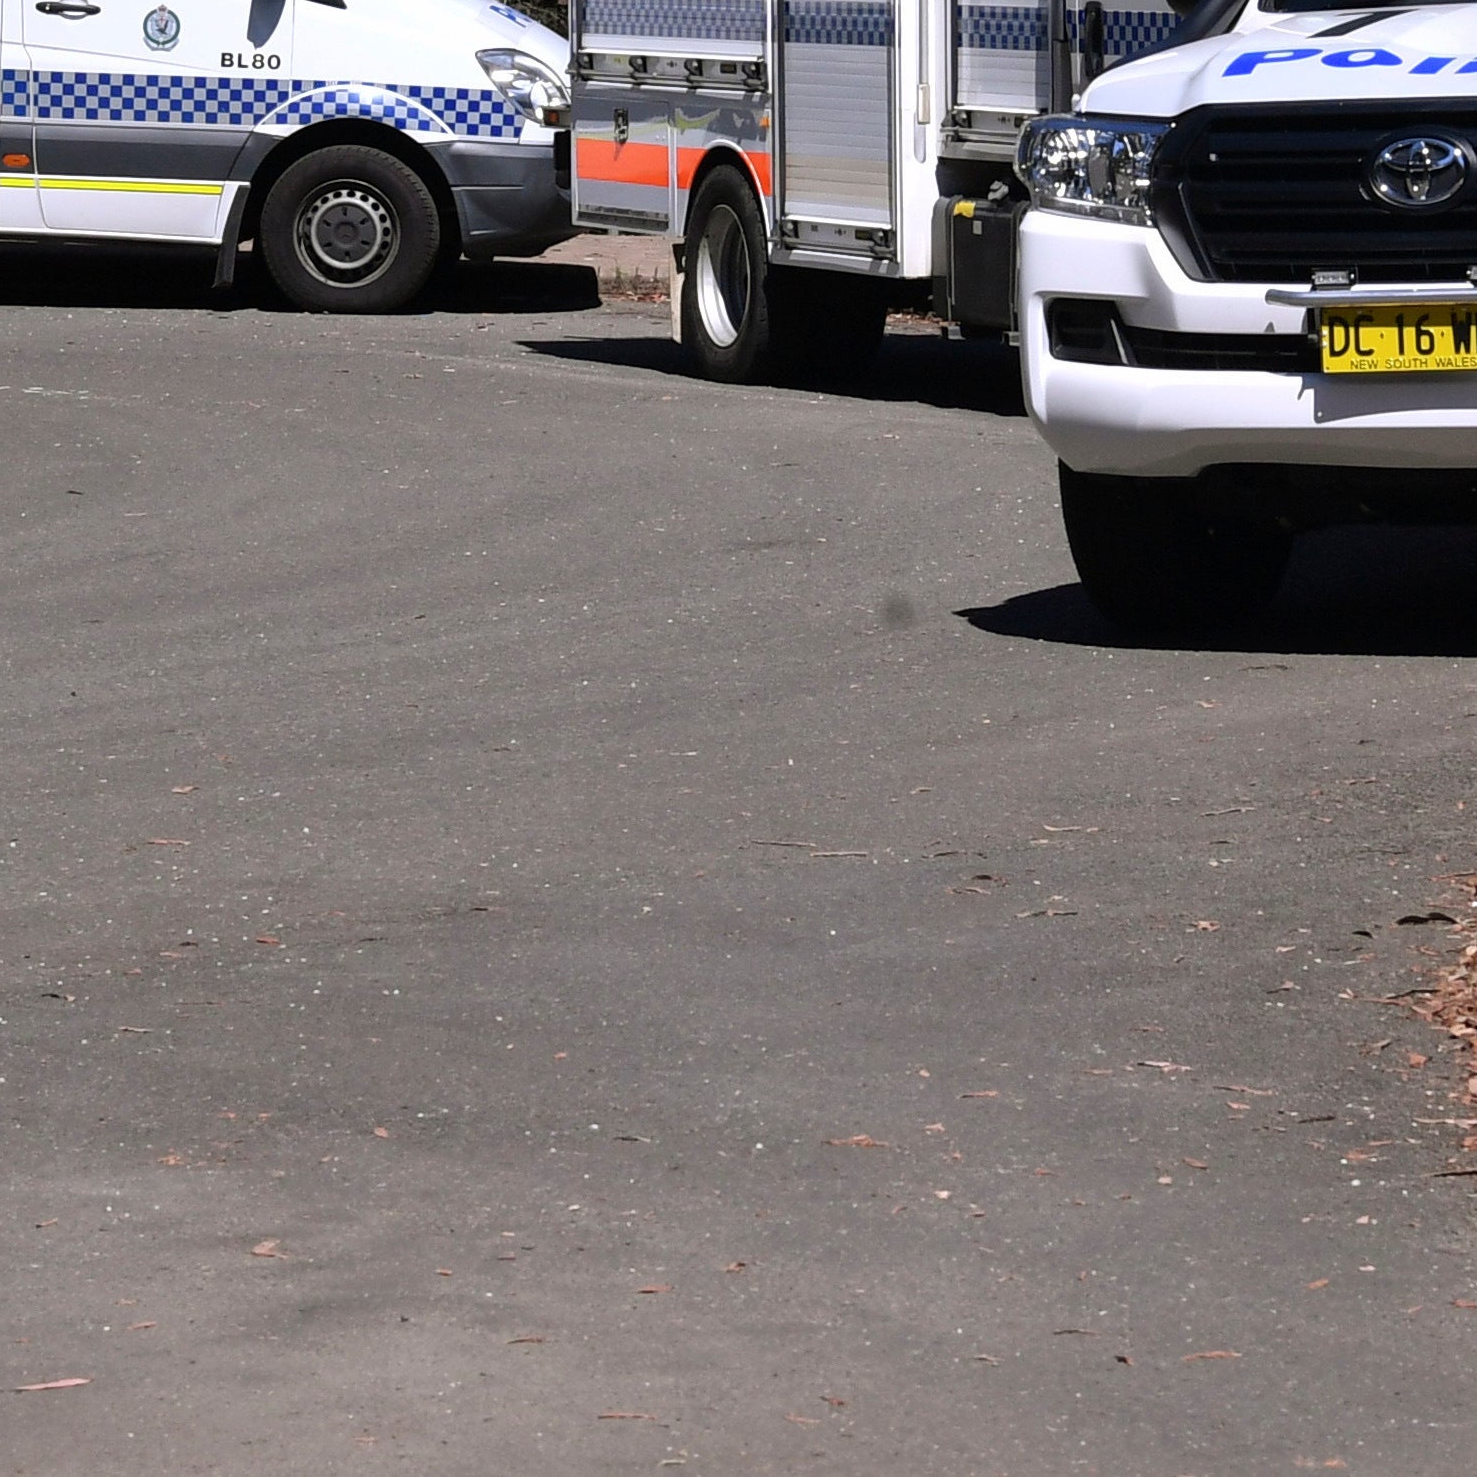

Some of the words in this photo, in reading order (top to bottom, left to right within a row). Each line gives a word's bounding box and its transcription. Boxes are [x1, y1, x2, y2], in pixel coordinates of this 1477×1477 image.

[220, 52, 281, 70] BL80
[1328, 315, 1375, 357] DC
[1395, 312, 1435, 356] 16
[1350, 359, 1379, 370] NEW
[1385, 358, 1428, 369] SOUTH
[1435, 356, 1477, 367] WALES
